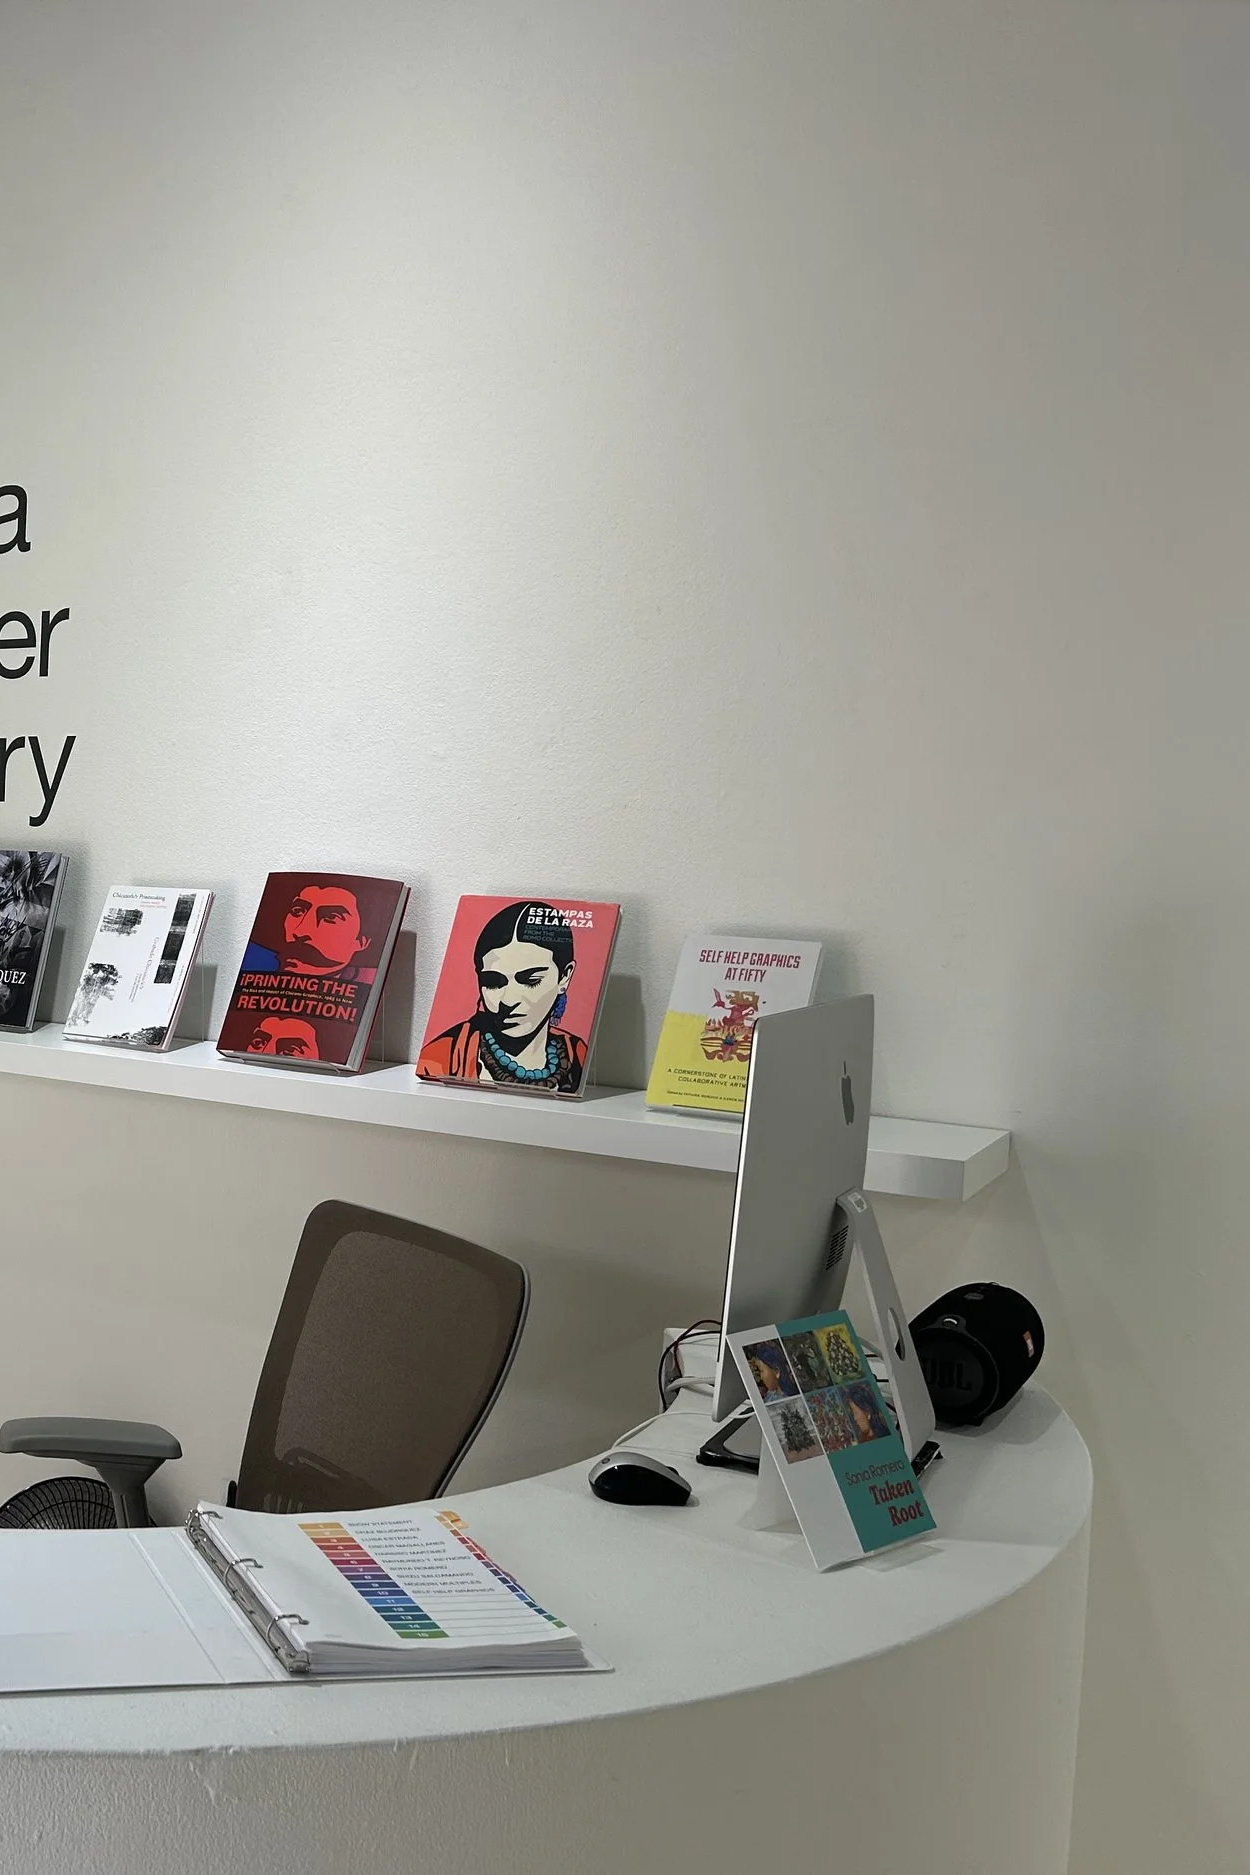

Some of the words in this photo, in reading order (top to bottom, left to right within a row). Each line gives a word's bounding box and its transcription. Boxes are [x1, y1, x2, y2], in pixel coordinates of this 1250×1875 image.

[527, 916, 543, 925] DE
[544, 917, 559, 926] LA
[561, 918, 594, 928] RAZA
[529, 907, 593, 919] ESTAMPAS
[699, 949, 724, 964] SELF
[724, 950, 749, 966] HELP
[749, 951, 802, 969] GRAPHICS
[725, 967, 739, 981] AT
[738, 968, 767, 983] FIFTY
[240, 973, 319, 991] ¡PRINTING
[322, 979, 359, 998] THE
[237, 995, 358, 1023] REVOLUTION!
[673, 1068, 718, 1078] CORNERSTONE
[678, 1076, 728, 1087] COLLABORATIVE
[845, 1470, 870, 1486] Sonia
[869, 1460, 905, 1479] Romero
[869, 1479, 915, 1505] Taken
[888, 1500, 925, 1527] Root
